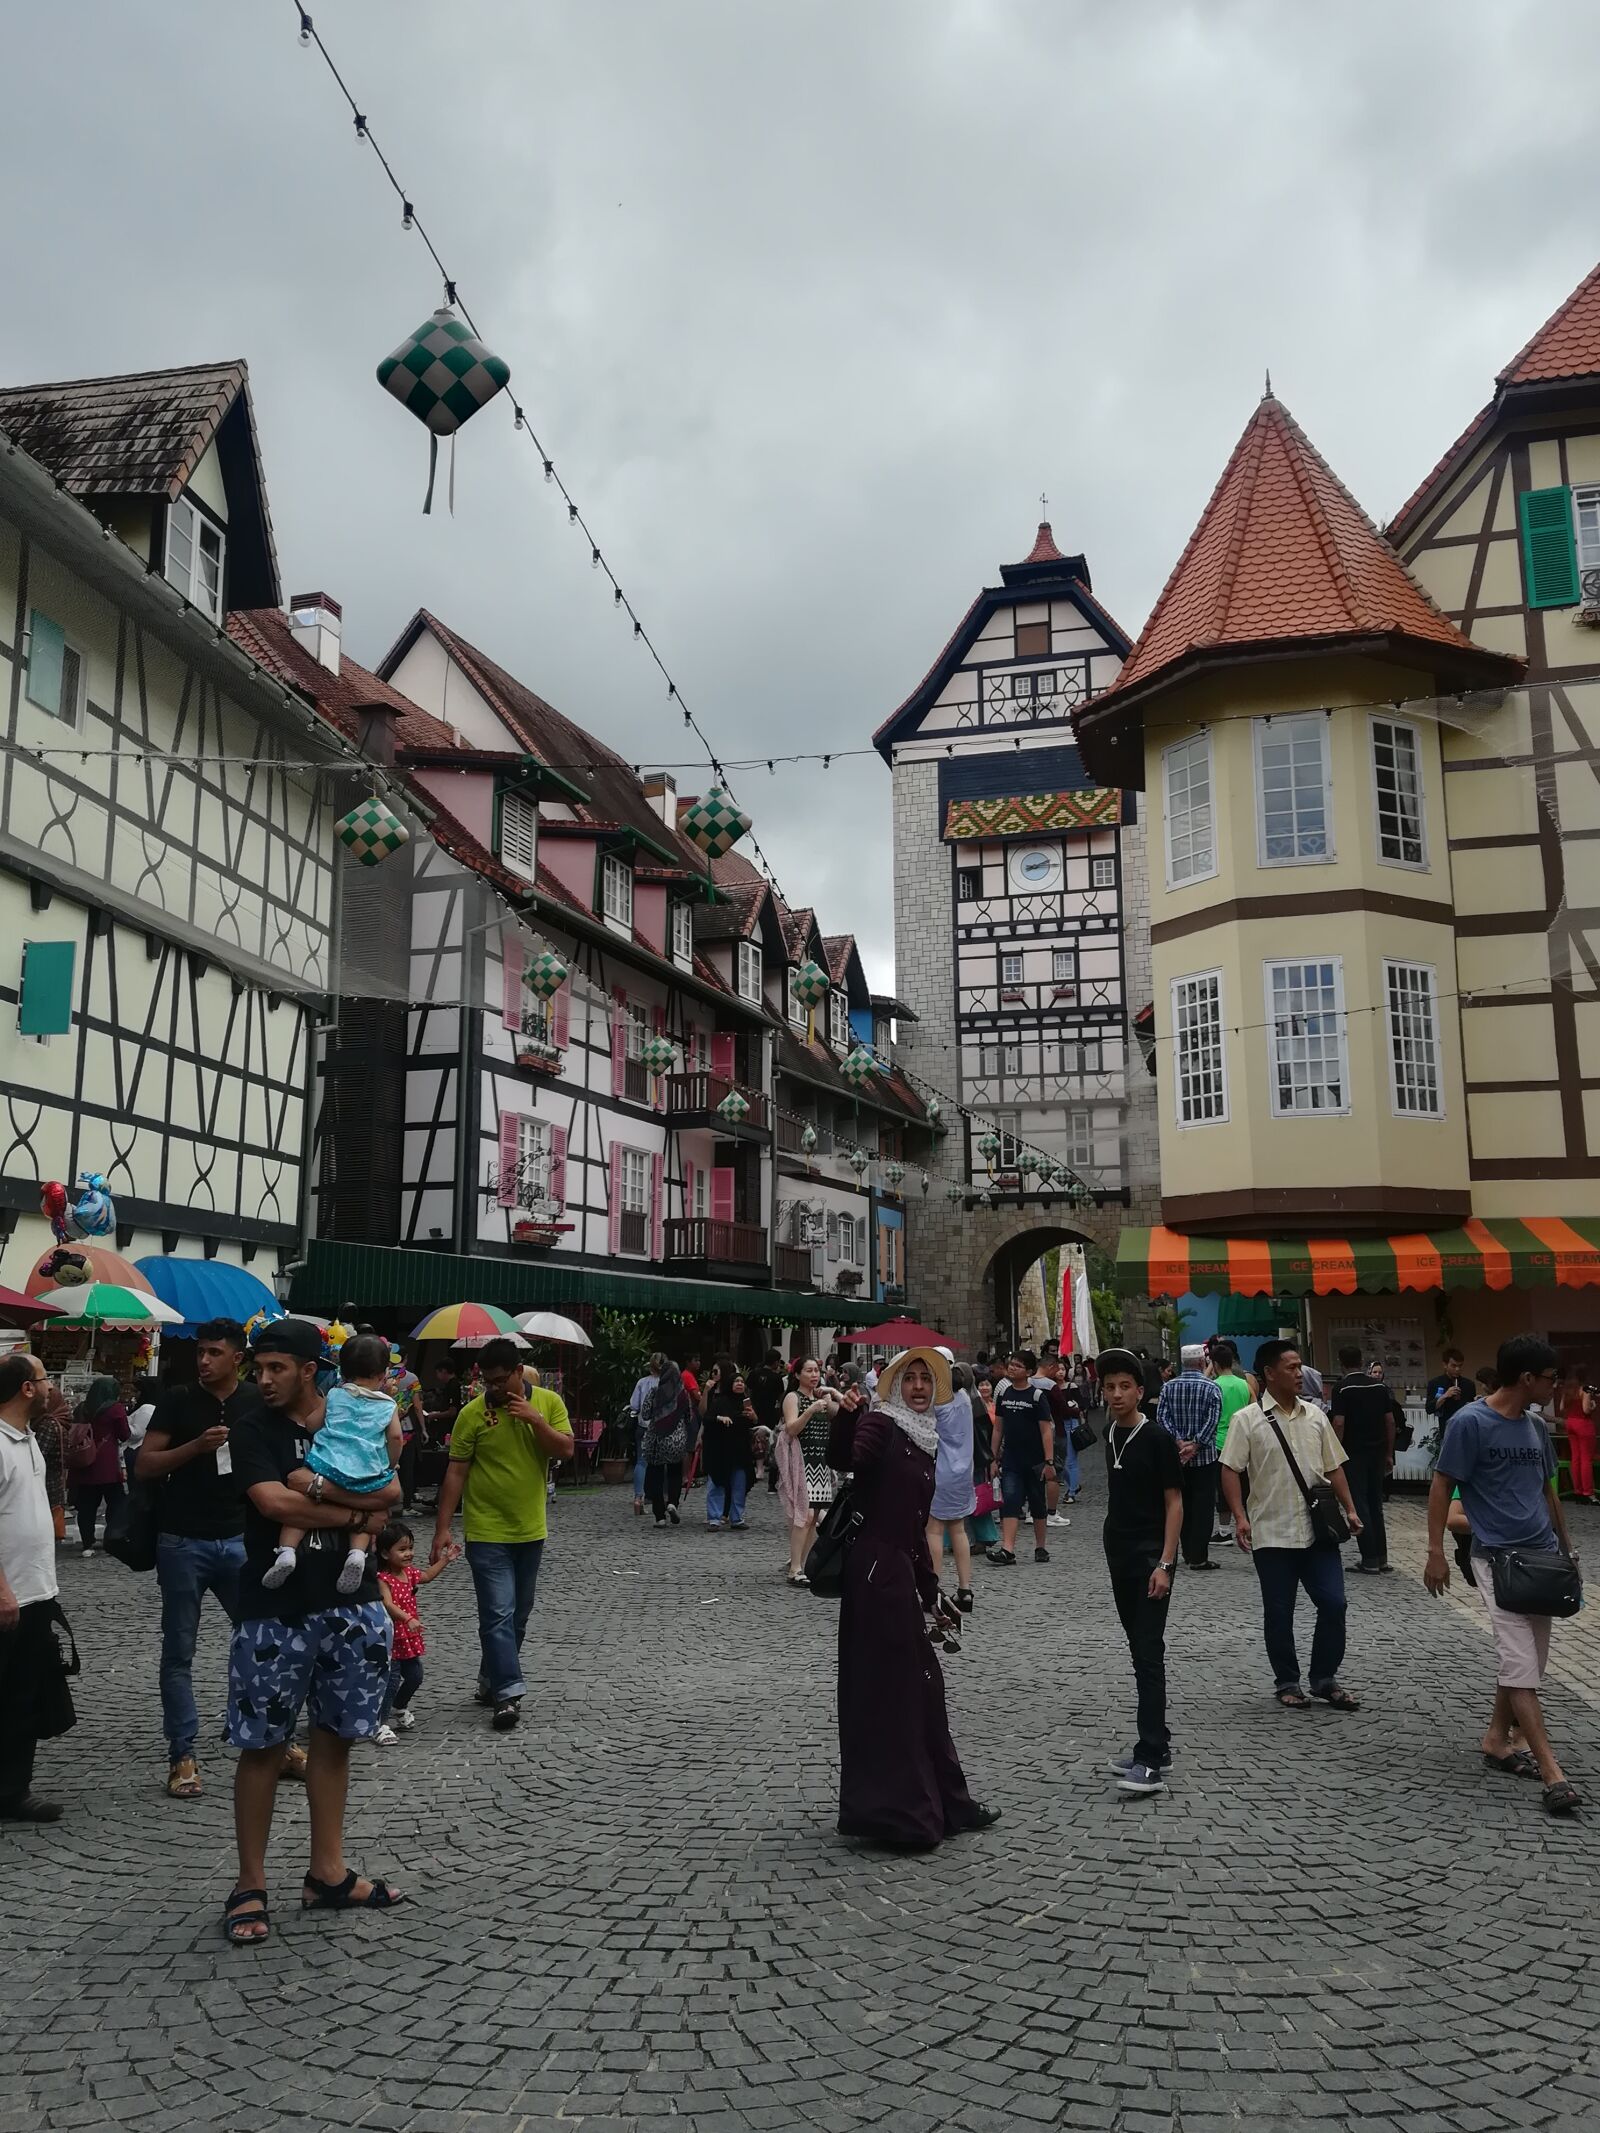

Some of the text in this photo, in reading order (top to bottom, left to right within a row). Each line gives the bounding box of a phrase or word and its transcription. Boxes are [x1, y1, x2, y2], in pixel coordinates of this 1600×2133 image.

[1289, 1260, 1355, 1271] ICE CREAM
[1417, 1255, 1484, 1266] ICE CREAM
[1530, 1255, 1550, 1265] ICE
[1166, 1263, 1230, 1274] ICE CREAM
